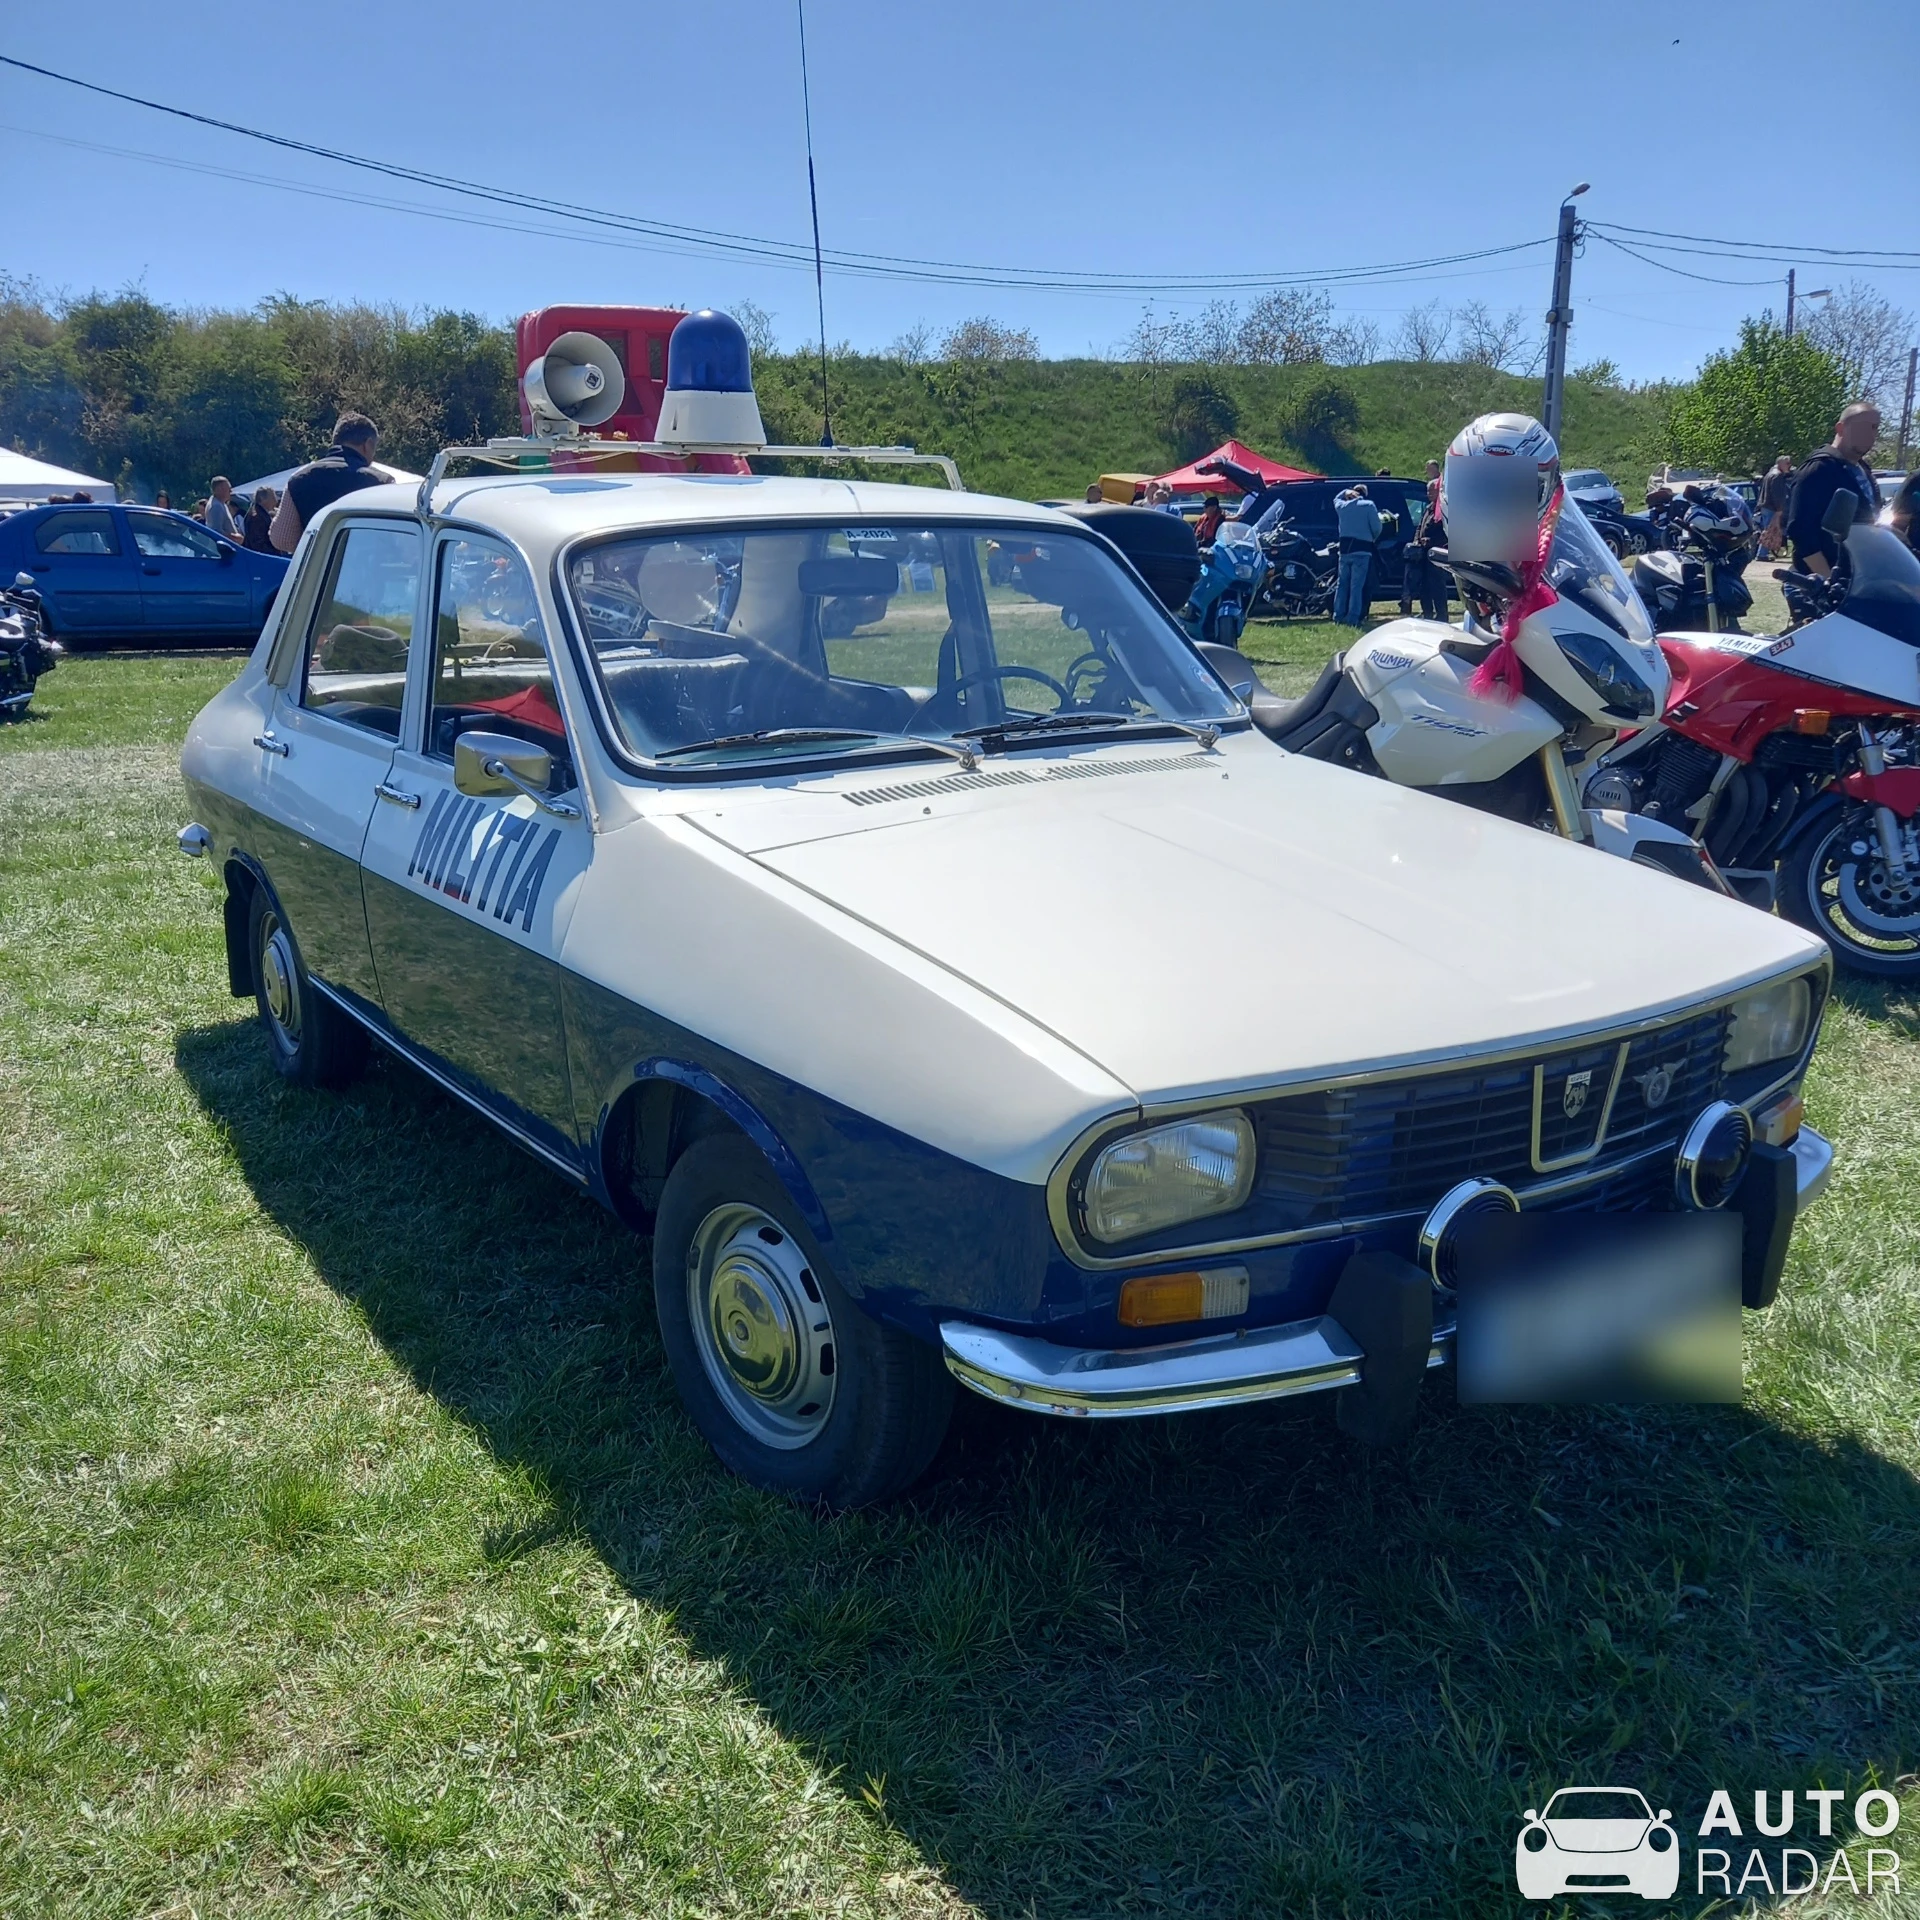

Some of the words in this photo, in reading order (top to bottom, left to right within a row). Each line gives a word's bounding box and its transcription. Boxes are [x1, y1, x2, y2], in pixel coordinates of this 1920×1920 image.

[1718, 637, 1762, 652] YAMAH
[1367, 649, 1414, 669] TRIUMPH
[1411, 713, 1489, 735] Tiger
[407, 788, 562, 933] MILITIA
